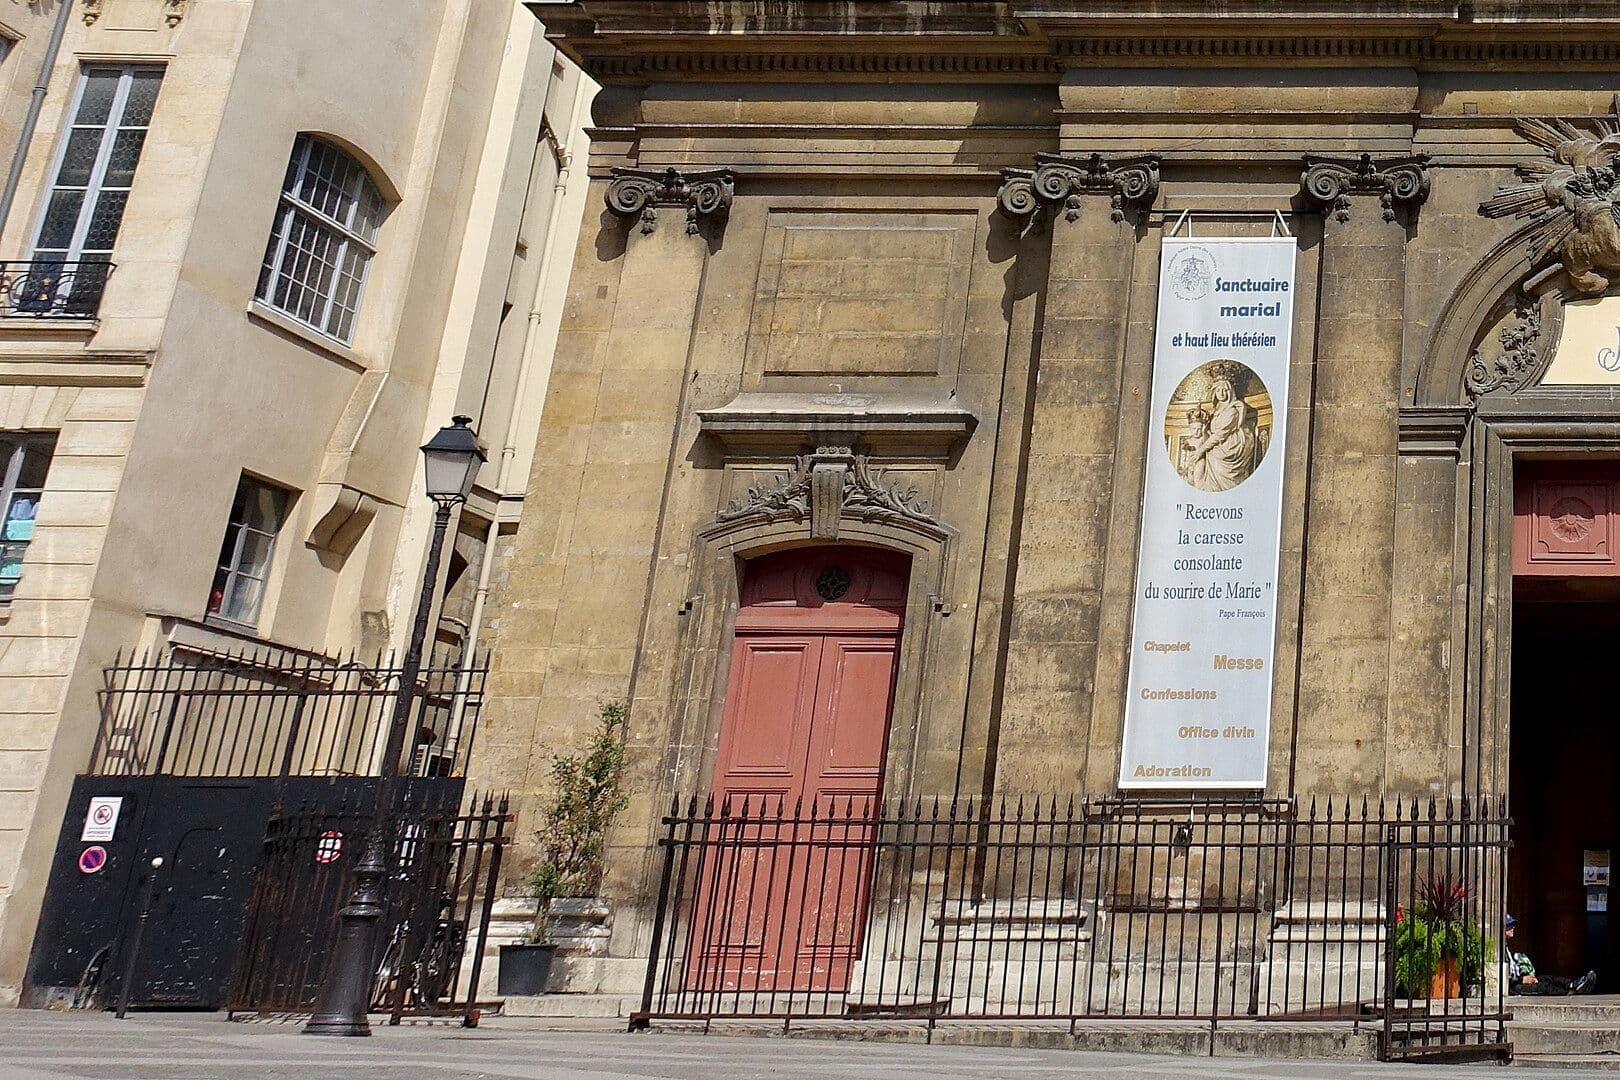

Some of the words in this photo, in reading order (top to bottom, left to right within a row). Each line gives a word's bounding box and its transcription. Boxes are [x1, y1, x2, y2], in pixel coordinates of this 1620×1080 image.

[1214, 277, 1289, 292] Sanctuaire
[1220, 302, 1280, 316] marial
[1172, 334, 1182, 347] et
[1185, 332, 1208, 347] haut
[1211, 332, 1229, 347] lieu
[1232, 332, 1276, 347] thérésien
[1184, 503, 1243, 520] Recevons
[1178, 530, 1189, 545] la
[1194, 533, 1244, 545] caresse
[1174, 554, 1242, 570] consolante
[1144, 582, 1159, 599] du
[1163, 582, 1204, 599] sourire
[1208, 582, 1222, 599] de
[1225, 581, 1261, 599] Marie
[1218, 609, 1235, 620] Pape
[1236, 608, 1266, 620] François
[1144, 641, 1191, 653] Chapelet
[1213, 655, 1264, 670] Messe
[1141, 688, 1217, 700] Confessions
[1178, 726, 1219, 738] Office
[1223, 726, 1255, 738] divin
[1134, 765, 1212, 777] Adoration
